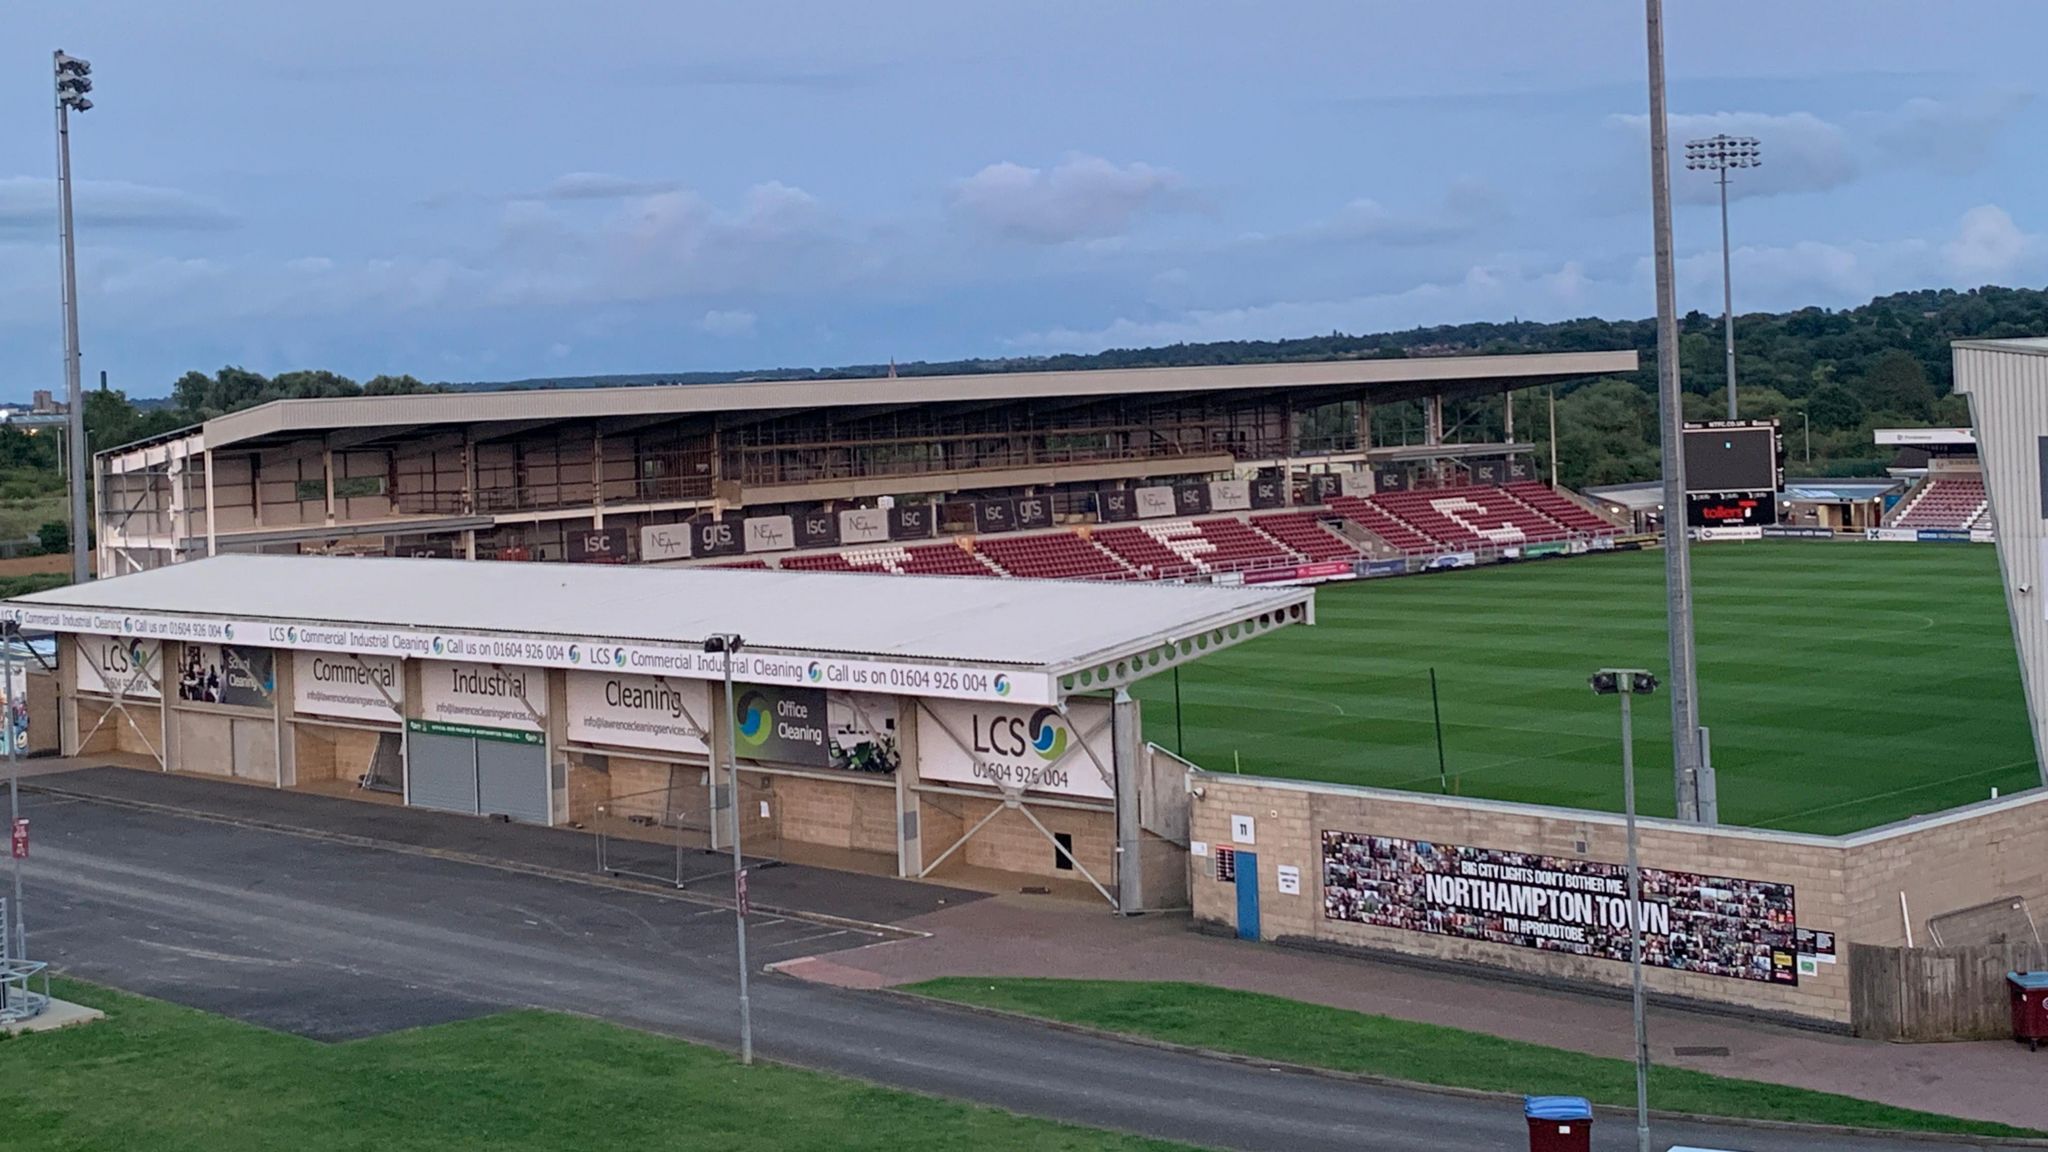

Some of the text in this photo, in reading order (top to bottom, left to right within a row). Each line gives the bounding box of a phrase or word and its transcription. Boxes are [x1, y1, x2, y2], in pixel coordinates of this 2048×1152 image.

[25, 613, 60, 626] Commercial
[62, 614, 92, 627] Industrial
[94, 616, 122, 632] Cleaning
[135, 619, 147, 632] Call
[149, 623, 157, 633] us
[159, 623, 168, 634] on
[169, 623, 192, 636] 01604
[193, 624, 207, 637] 926
[208, 625, 222, 637] 004
[269, 626, 564, 660] LCS Commercial Industrial Cleaning Call us on 01604 926 004
[102, 643, 128, 674] LCS
[313, 657, 395, 687] Commercial
[590, 648, 610, 665] LCS
[631, 651, 692, 670] Commercial
[754, 660, 803, 682] Cleaning
[827, 664, 849, 682] Call
[853, 669, 867, 683] us
[871, 670, 886, 685] on
[891, 668, 930, 688] 01604
[934, 672, 959, 690] 926
[962, 674, 987, 692] 004
[453, 668, 527, 698] Industrial
[605, 680, 682, 718] Cleaning
[777, 700, 808, 718] Office
[778, 722, 822, 745] Cleaning
[972, 714, 1026, 758] LCS
[973, 761, 1068, 788] 01604 926 004
[1240, 823, 1247, 836] 11
[1461, 860, 1478, 876] BIG
[1478, 862, 1500, 879] CITY
[1500, 865, 1534, 883] LIGHTS
[1535, 869, 1563, 888] DON'T
[1565, 873, 1605, 893] BOTHER
[1425, 873, 1669, 935] NORTHAMPTON TOWN
[1503, 917, 1586, 942] I'M #PROUDTOBE
